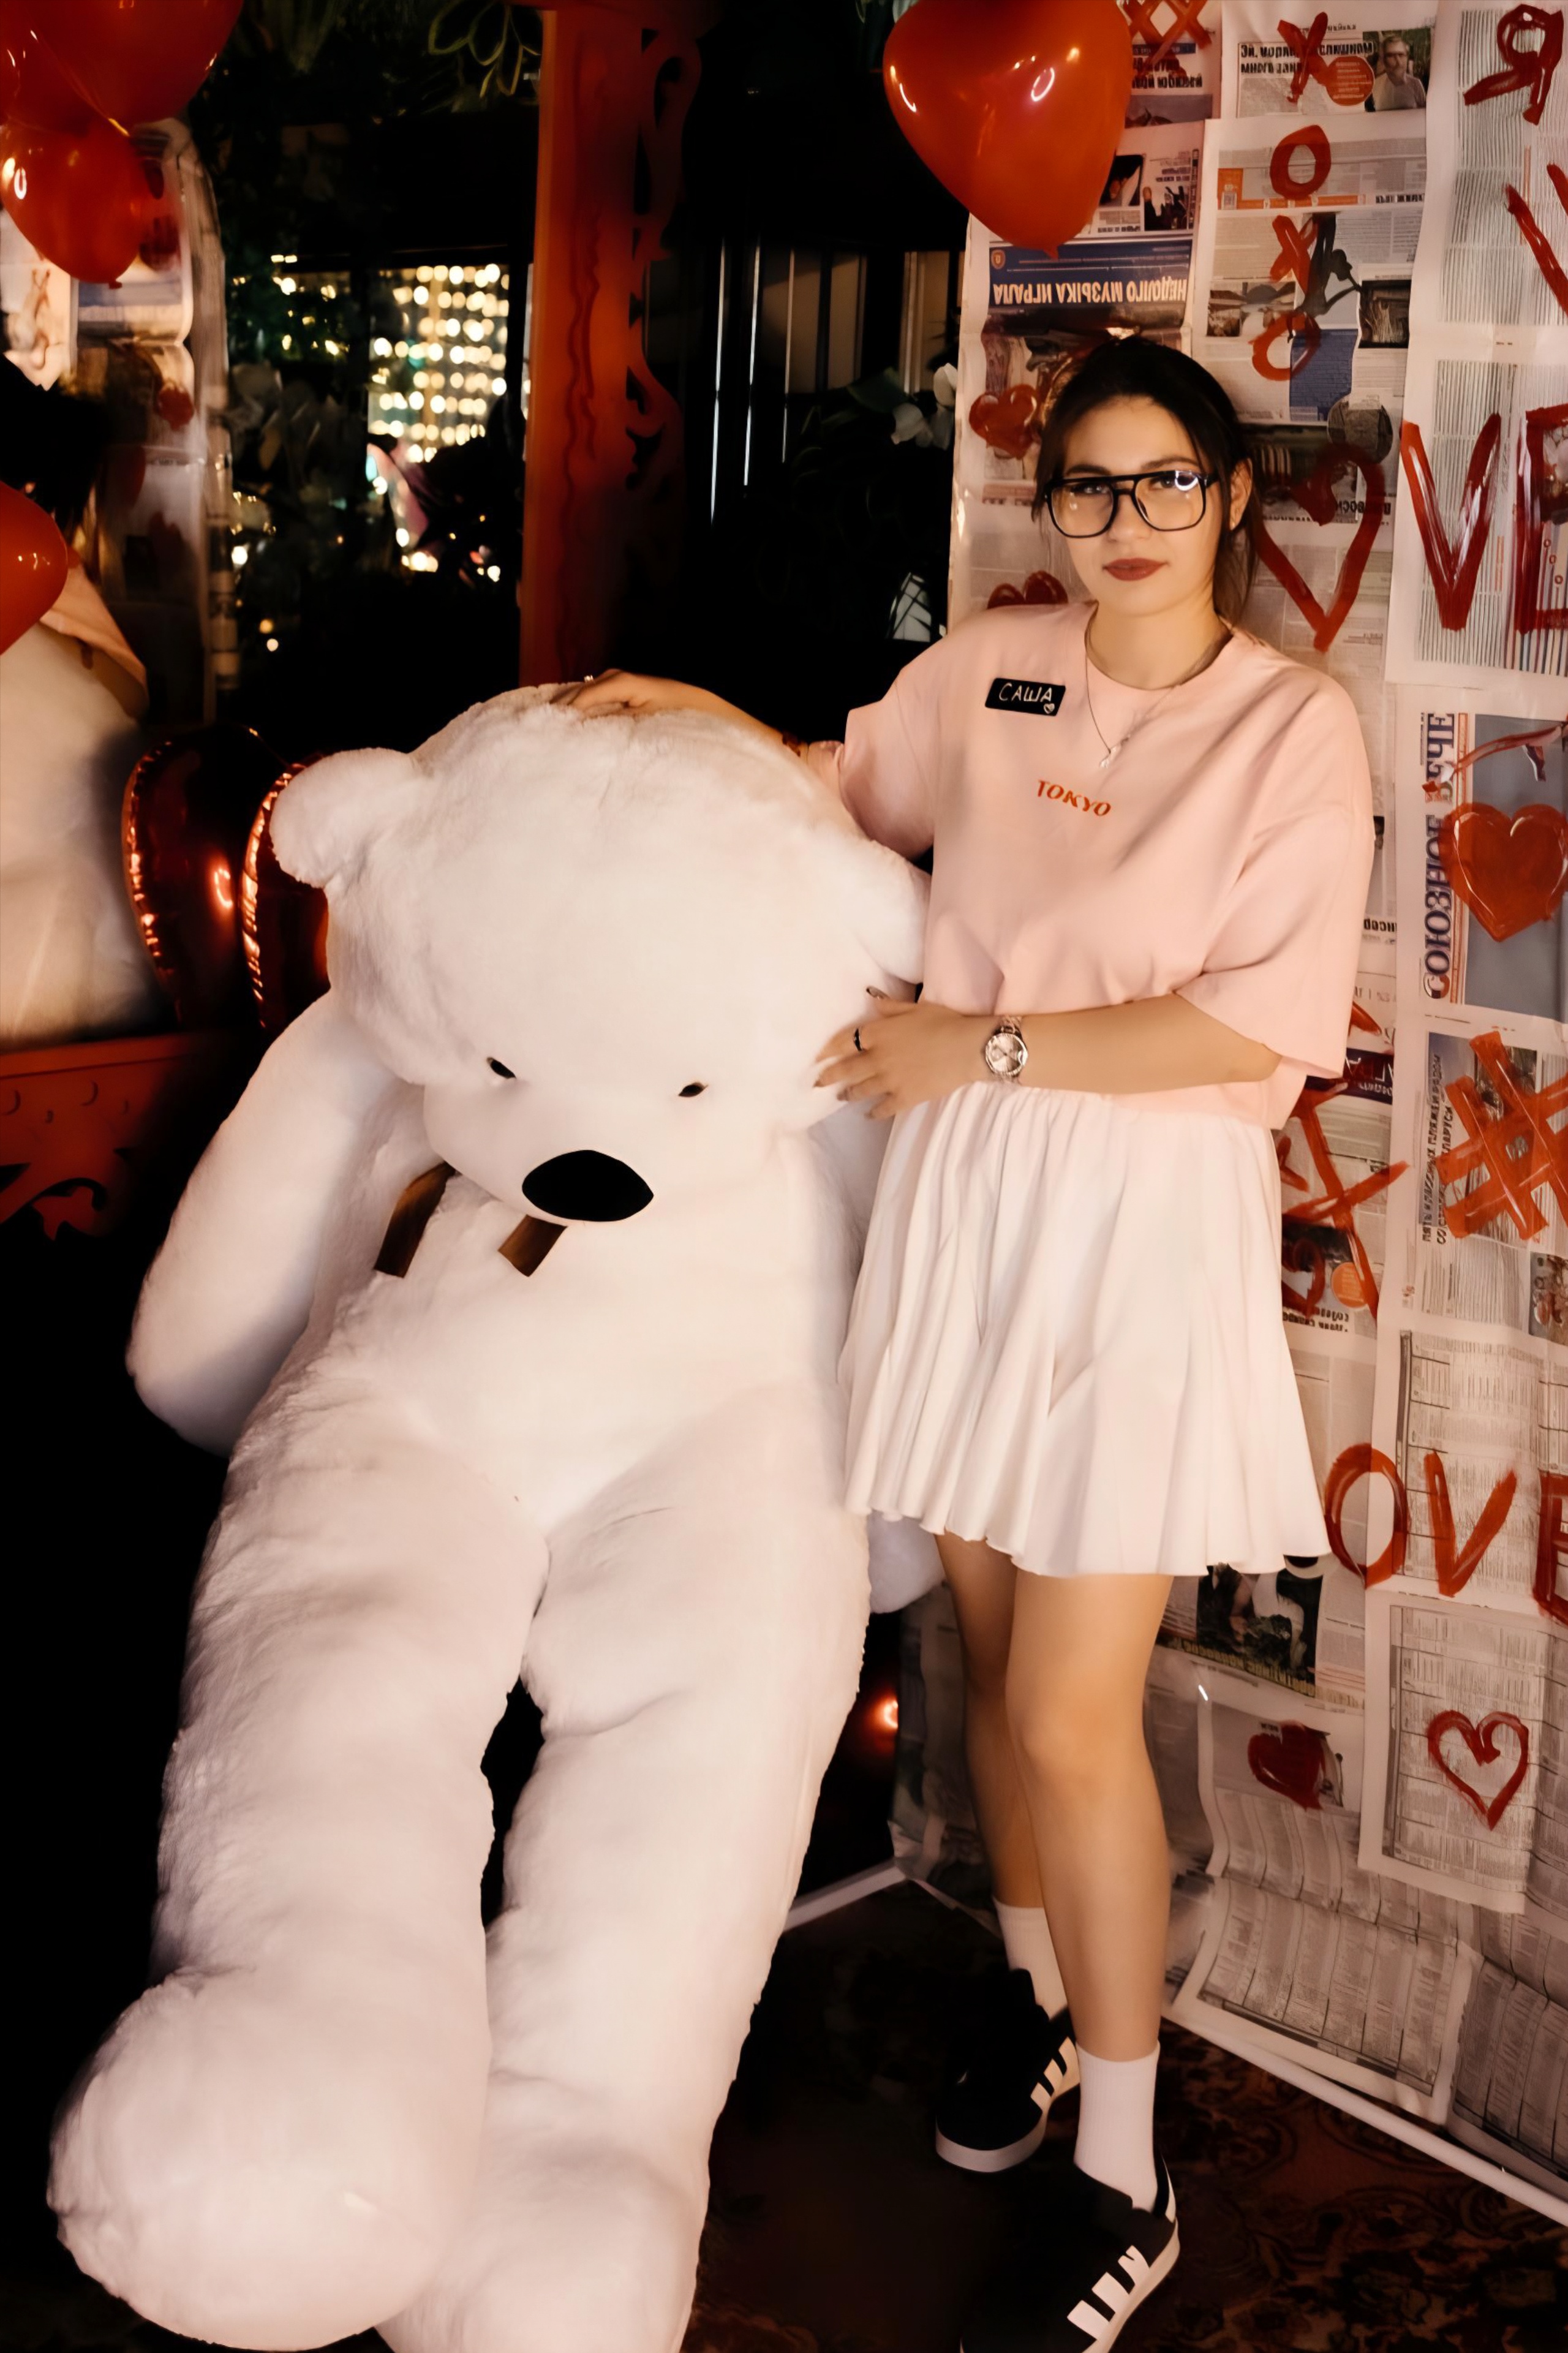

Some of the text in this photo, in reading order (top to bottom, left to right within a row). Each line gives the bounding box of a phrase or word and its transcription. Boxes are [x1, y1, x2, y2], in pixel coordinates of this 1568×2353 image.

[992, 276, 1187, 305] НЕДОЛГО МУЗЫКА ИГРАЛА
[999, 682, 1052, 703] САША
[1038, 779, 1112, 817] TOKYO
